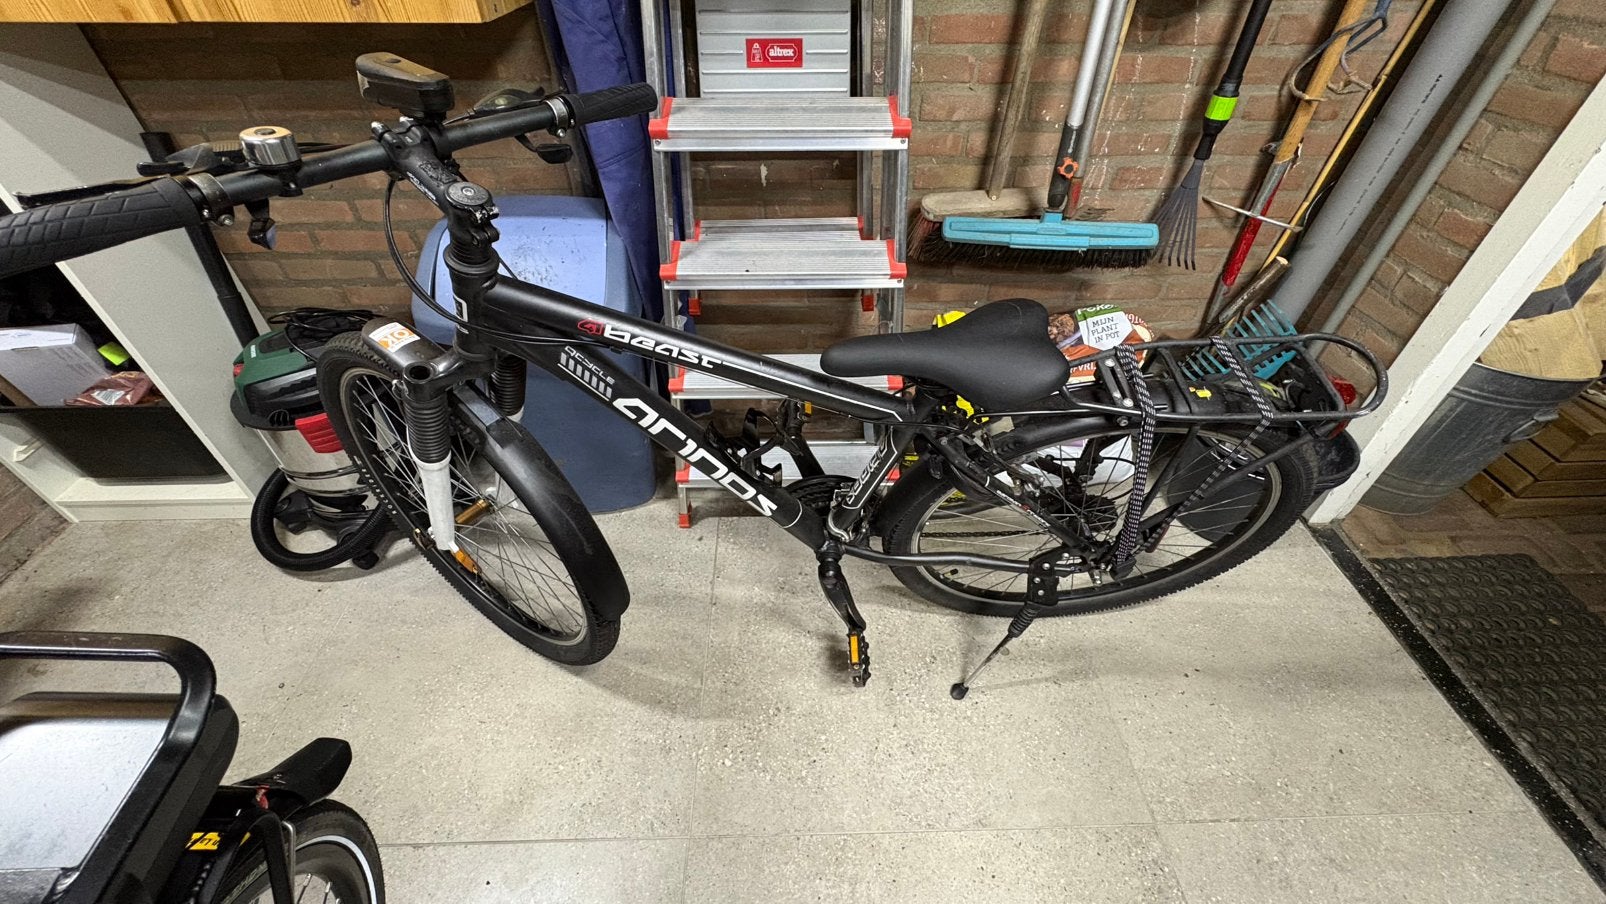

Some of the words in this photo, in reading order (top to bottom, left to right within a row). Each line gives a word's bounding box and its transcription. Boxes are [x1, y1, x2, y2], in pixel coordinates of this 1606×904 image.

[769, 45, 794, 56] altrex
[1092, 316, 1115, 328] MIJN
[1091, 323, 1119, 336] PLANT
[1094, 336, 1104, 344] IN
[1105, 331, 1121, 340] POT
